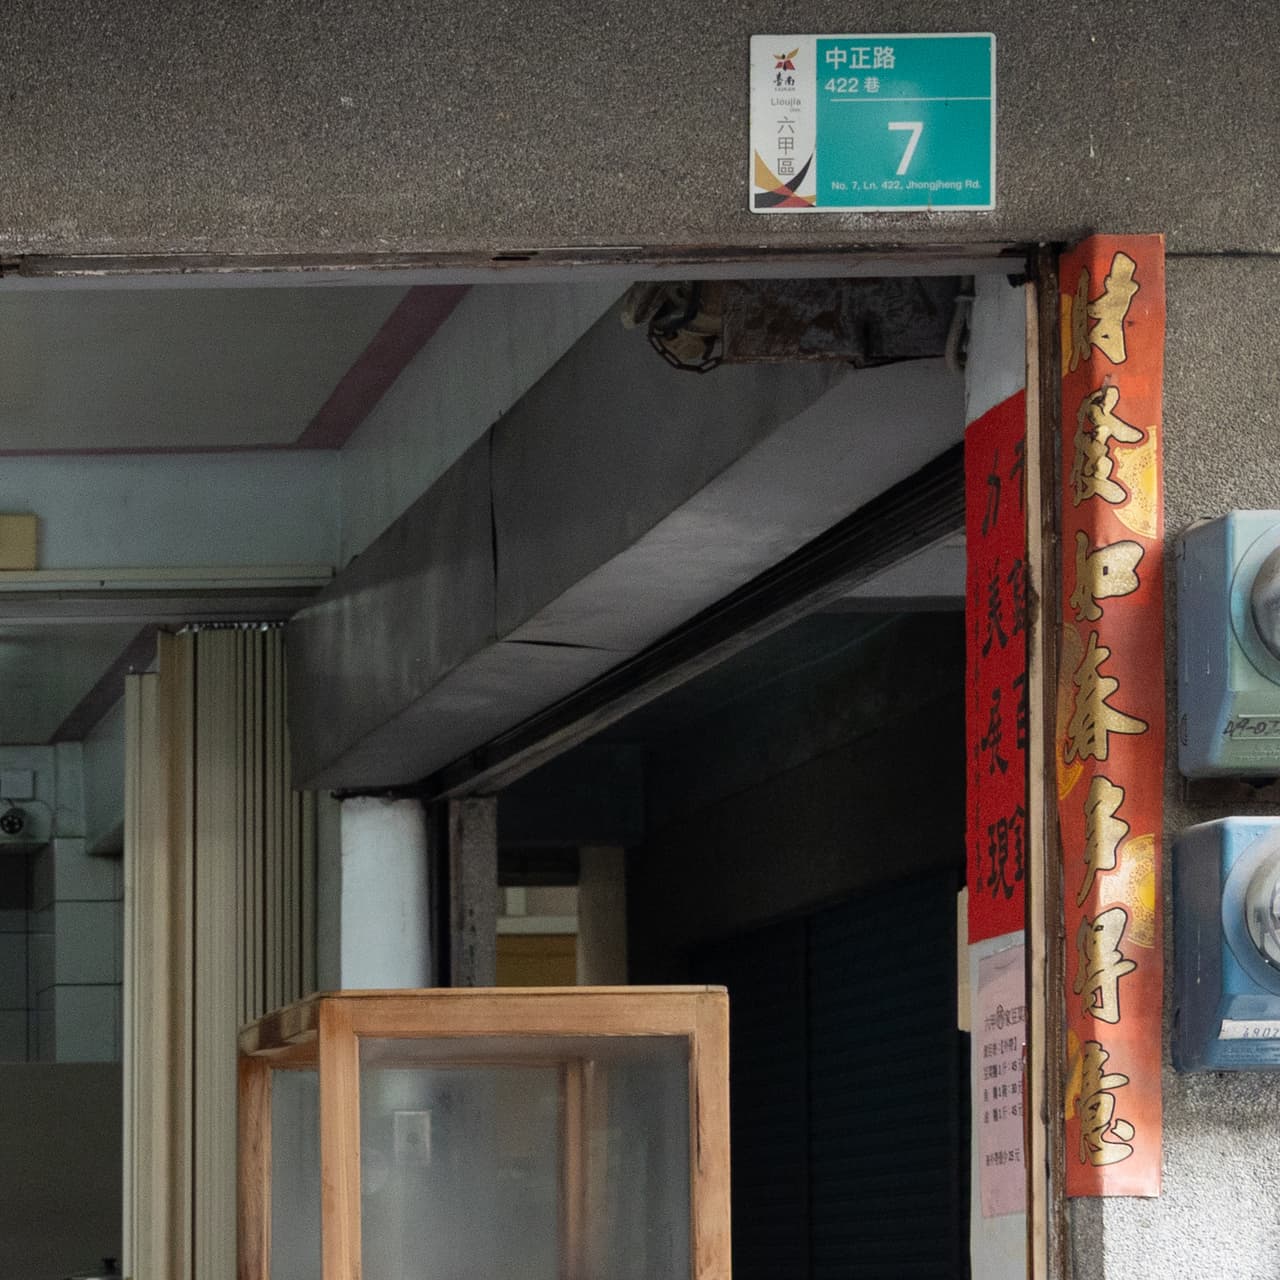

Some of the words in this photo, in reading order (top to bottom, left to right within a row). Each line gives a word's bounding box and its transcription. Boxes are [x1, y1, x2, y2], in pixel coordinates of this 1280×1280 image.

[825, 47, 895, 70] 中正路
[824, 78, 859, 93] 422
[863, 77, 880, 93] 巷
[776, 116, 796, 176] 六甲區
[888, 121, 924, 176] 7
[831, 181, 849, 191] No.
[852, 181, 861, 192] 7,
[863, 181, 878, 190] Ln.
[881, 180, 903, 191] 422,
[906, 180, 962, 192] Jhongjheng
[965, 180, 982, 190] Rd.
